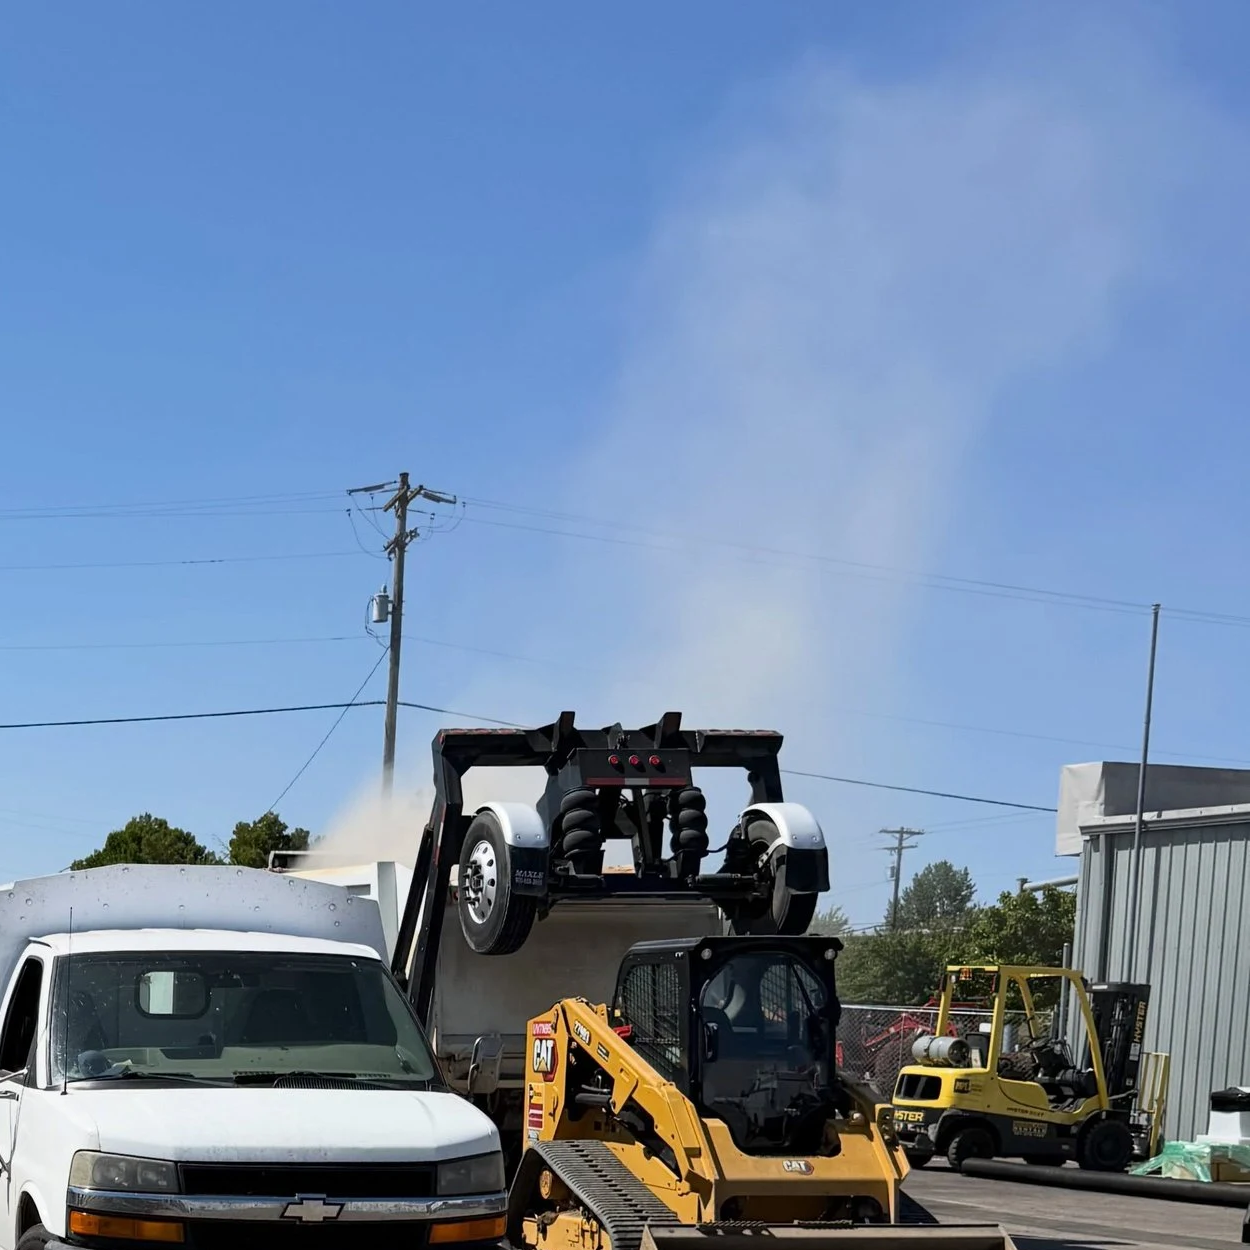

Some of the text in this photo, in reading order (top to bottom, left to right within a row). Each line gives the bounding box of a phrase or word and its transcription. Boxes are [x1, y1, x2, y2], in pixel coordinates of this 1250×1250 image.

[1133, 1001, 1146, 1042] HYSTER
[533, 1039, 554, 1072] CAT
[783, 1160, 806, 1171] CAT
